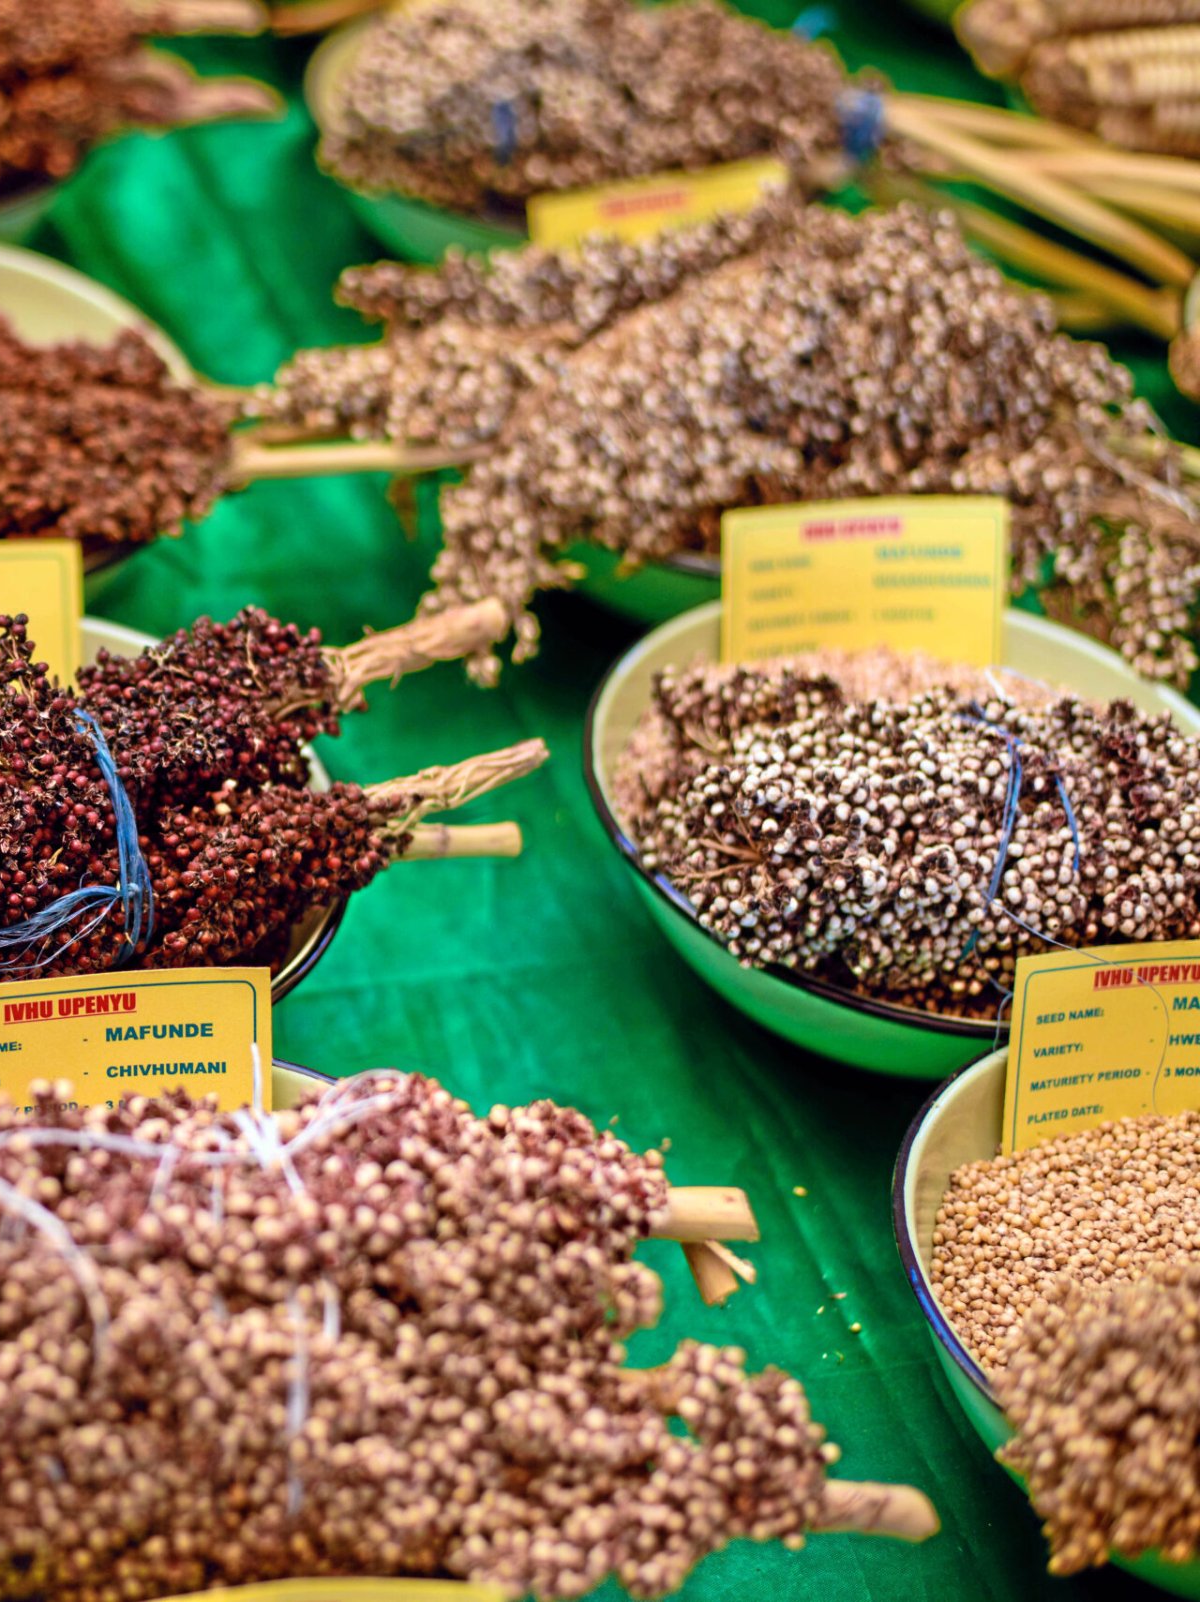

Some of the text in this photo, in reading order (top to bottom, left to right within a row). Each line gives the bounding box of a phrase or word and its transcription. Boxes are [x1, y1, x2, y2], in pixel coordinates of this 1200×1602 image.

[1094, 967, 1133, 987] IVHU
[4, 992, 136, 1023] IVHU UPENYU
[1036, 1012, 1065, 1025] SEED
[1068, 1007, 1104, 1021] NAME:
[105, 1022, 214, 1042] MAFUNDE
[1033, 1042, 1083, 1058] VARIETY:
[106, 1061, 227, 1079] CHIVHUMANI
[1030, 1073, 1095, 1092] MATURIETY
[1097, 1068, 1141, 1081] PERIOD
[1163, 1066, 1171, 1078] 3
[1027, 1108, 1068, 1125] PLATED
[1071, 1103, 1104, 1118] DATE:
